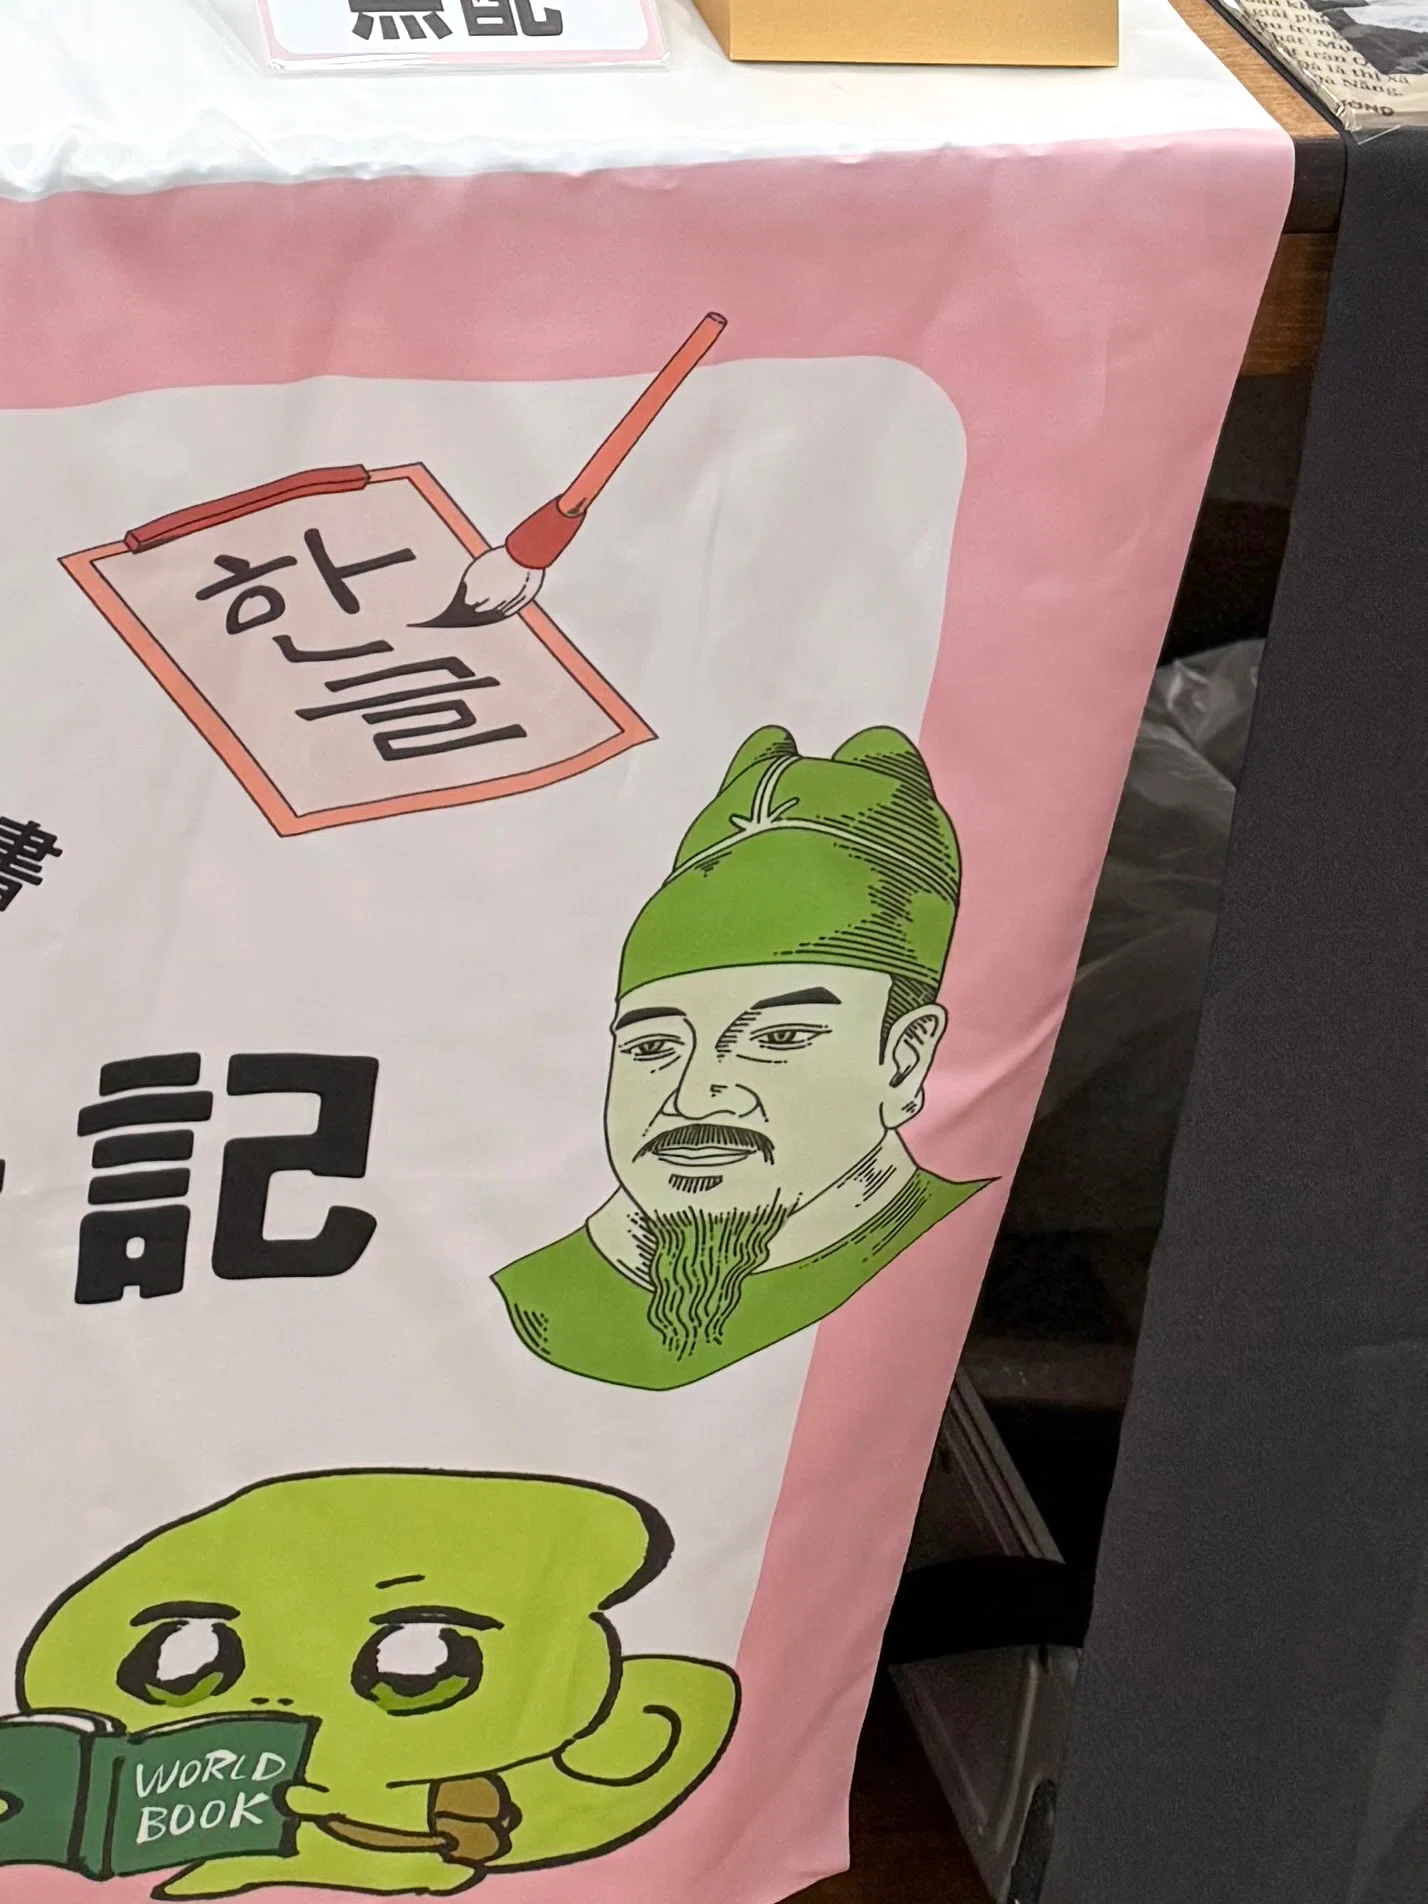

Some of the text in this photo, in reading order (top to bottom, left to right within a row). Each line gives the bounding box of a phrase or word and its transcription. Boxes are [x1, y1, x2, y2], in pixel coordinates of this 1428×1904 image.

[195, 528, 527, 761] 한글
[136, 1749, 286, 1797] WORLD
[136, 1792, 272, 1846] BOOK
